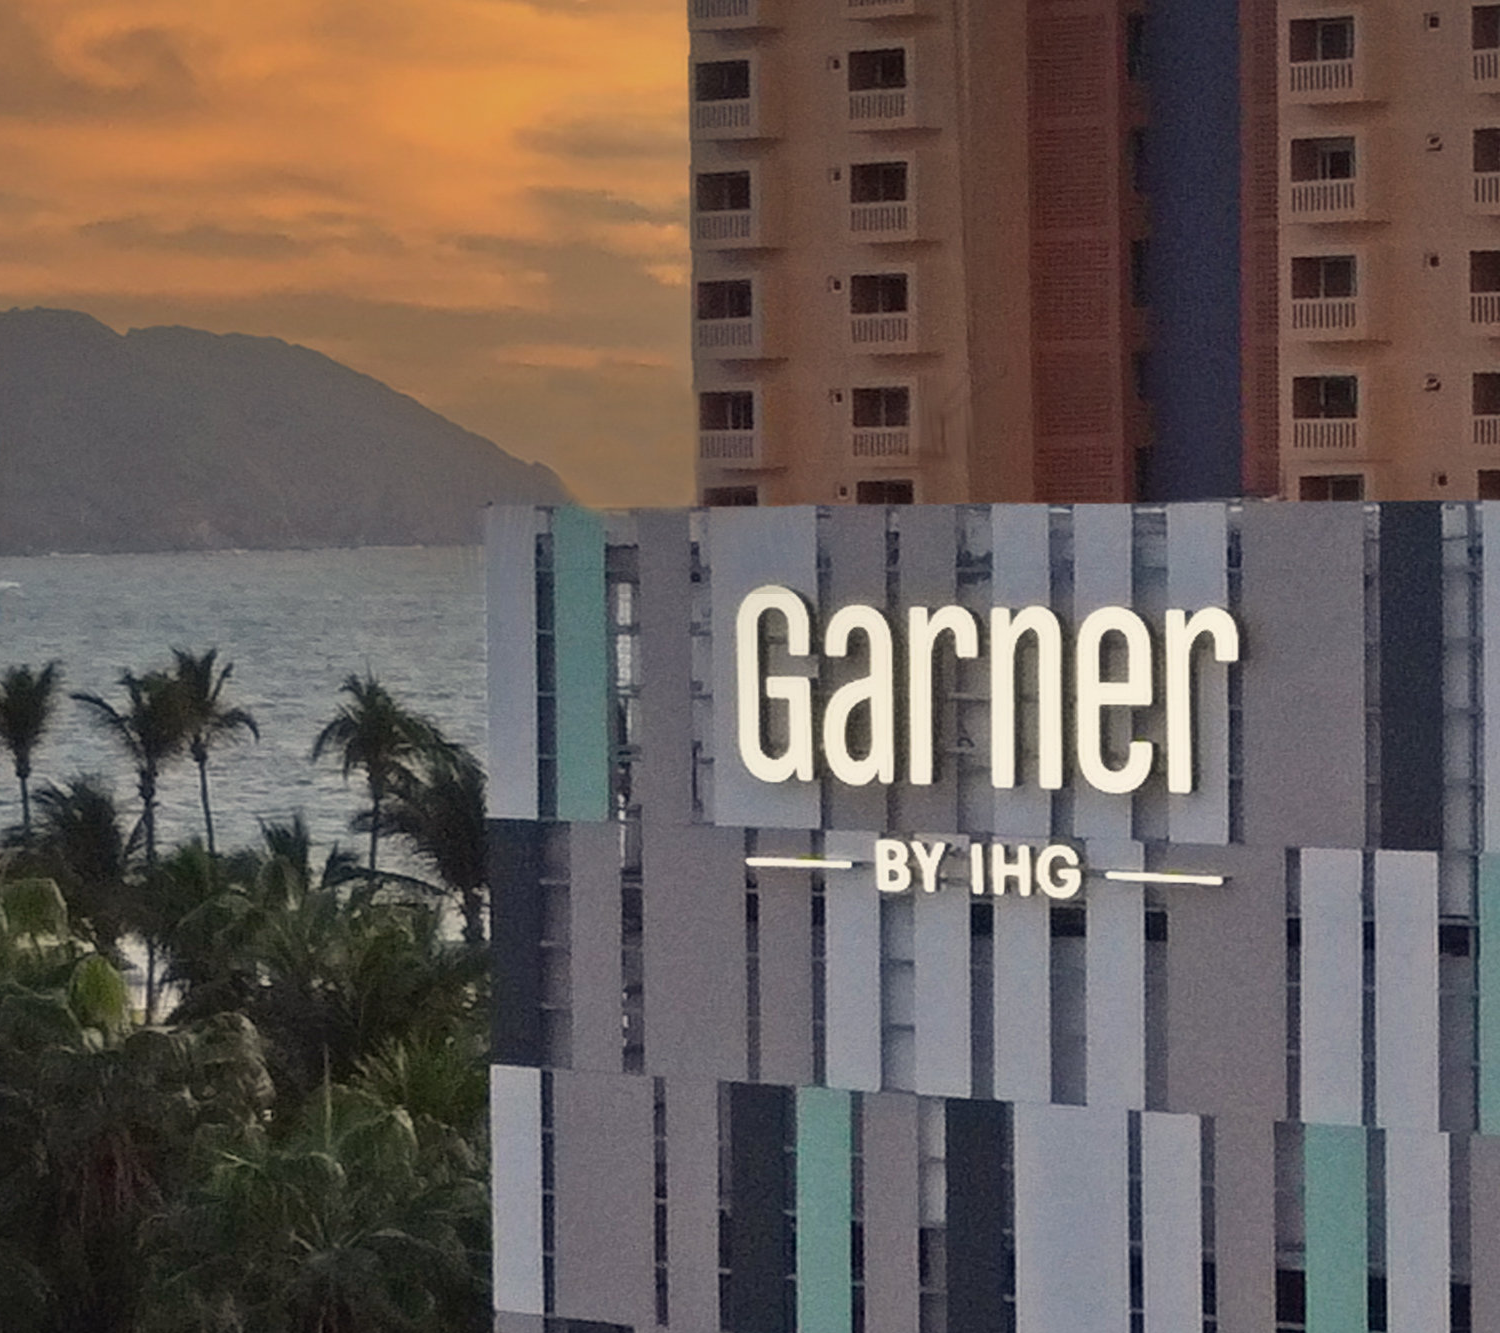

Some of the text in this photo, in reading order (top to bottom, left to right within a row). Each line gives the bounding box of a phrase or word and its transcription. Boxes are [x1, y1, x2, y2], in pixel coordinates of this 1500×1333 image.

[735, 584, 1240, 795] Garner
[875, 837, 1083, 900] BY IHG
